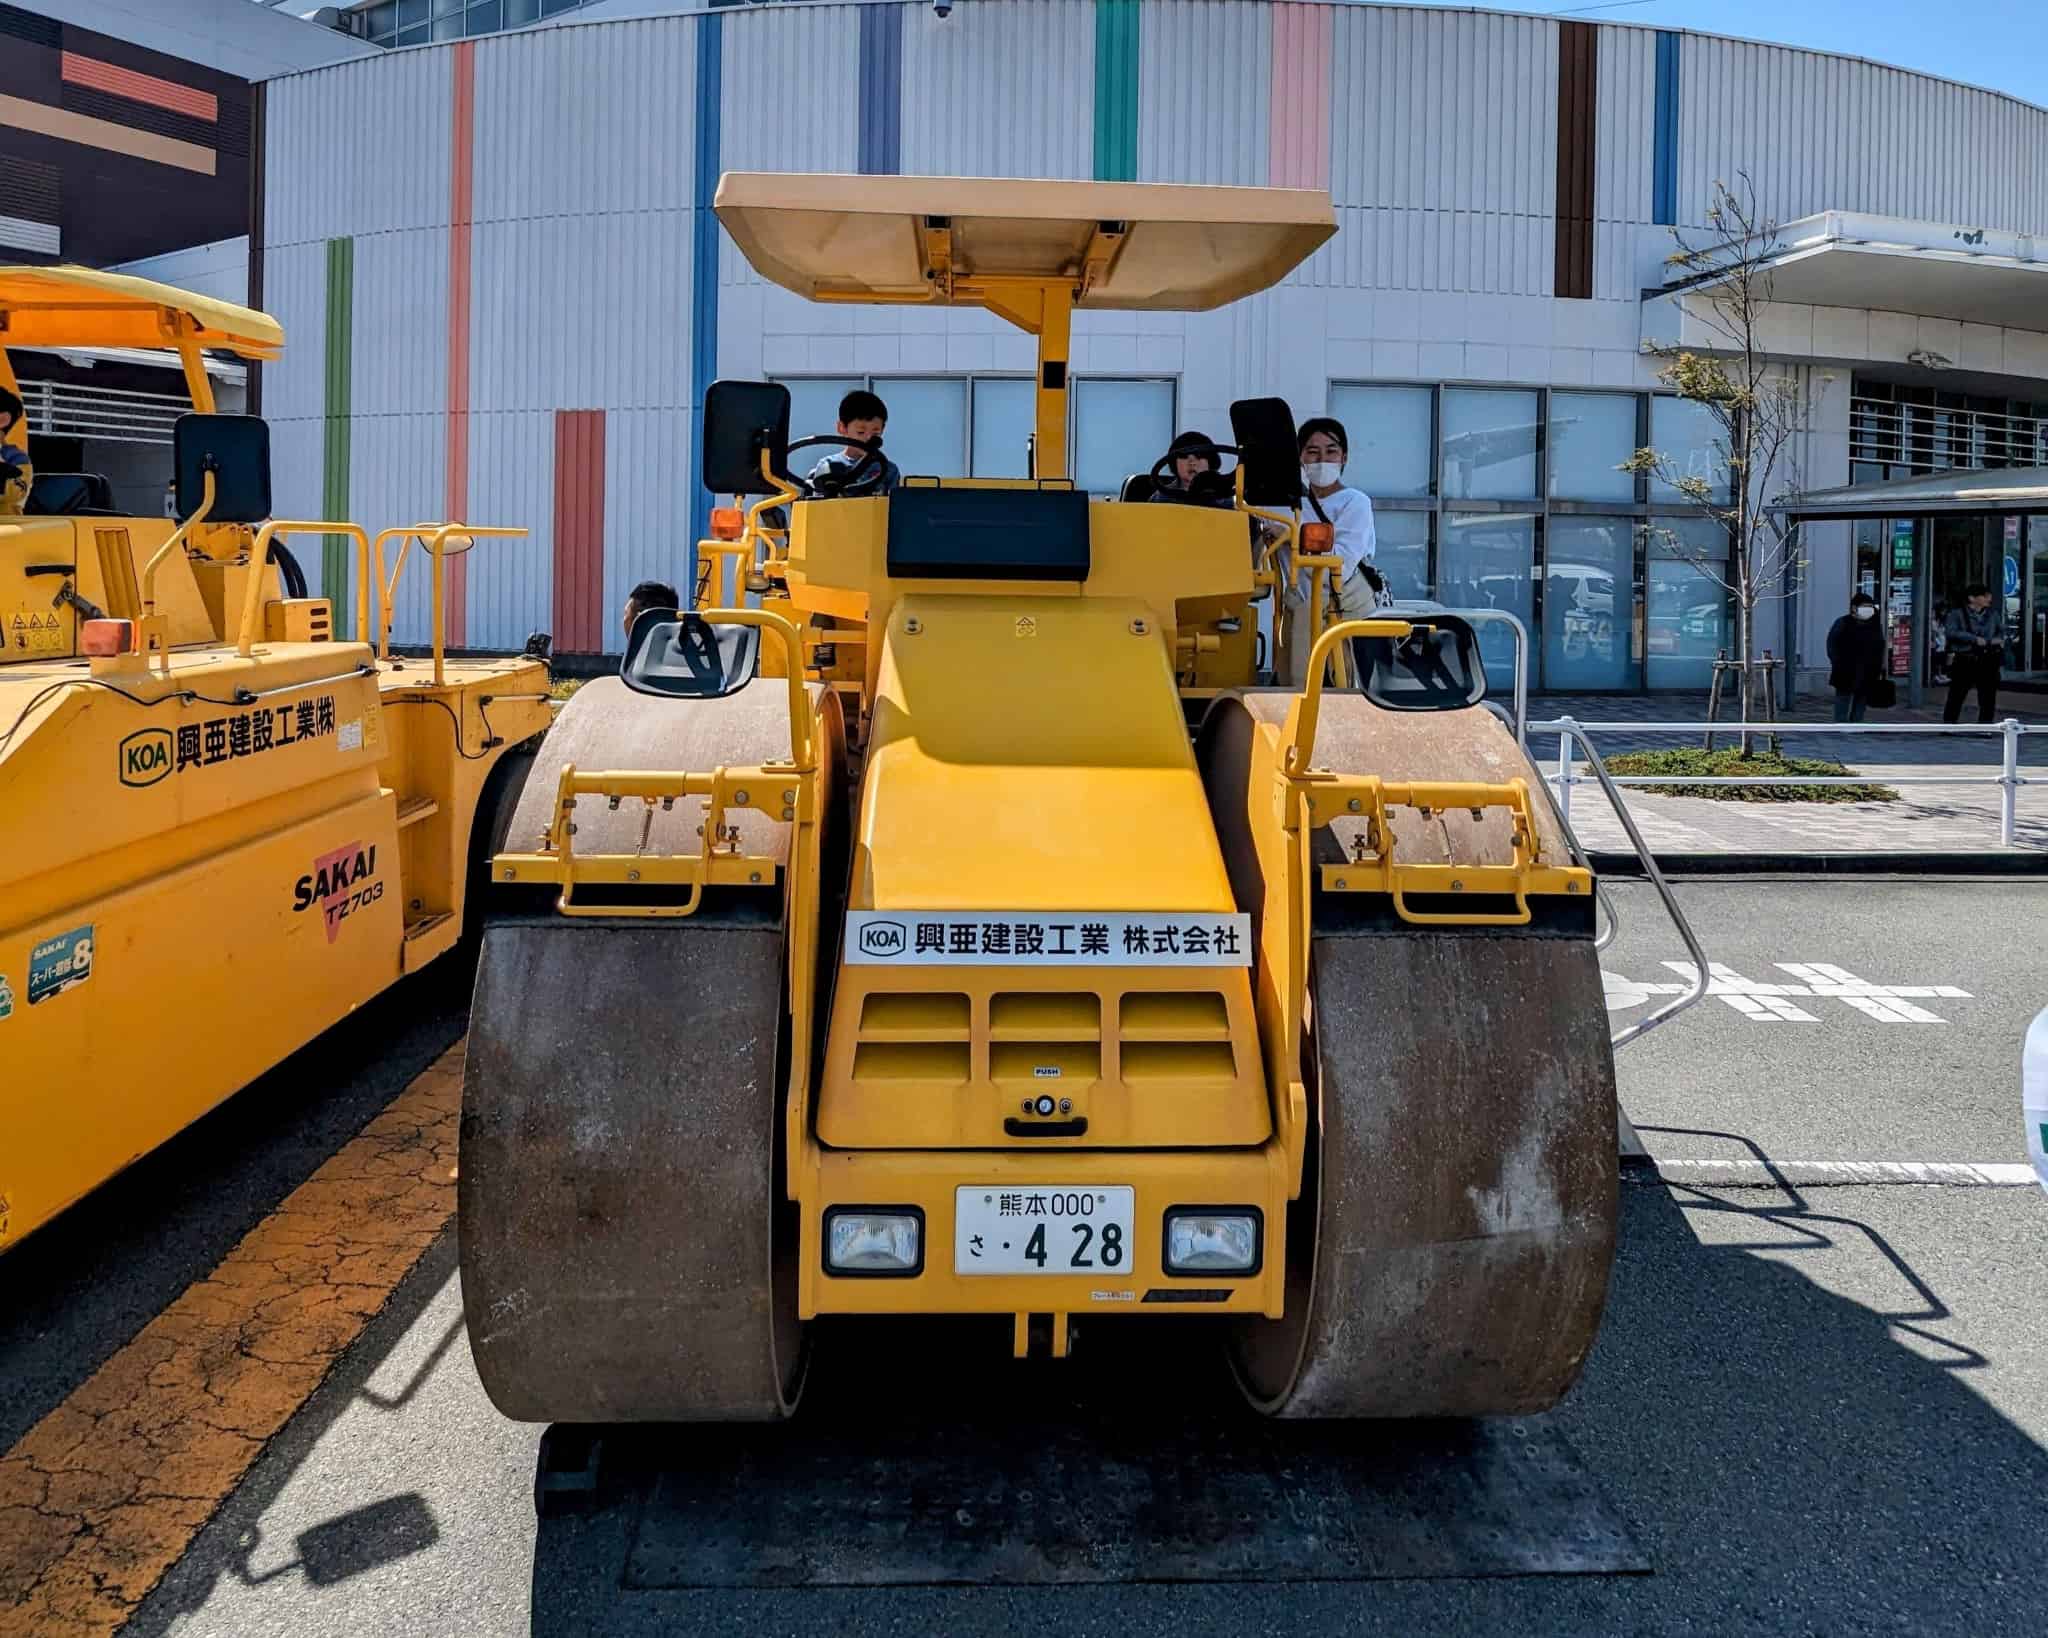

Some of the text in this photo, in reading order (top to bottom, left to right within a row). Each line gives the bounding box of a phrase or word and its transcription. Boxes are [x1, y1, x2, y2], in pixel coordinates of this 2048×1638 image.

[128, 741, 169, 774] KOA
[292, 845, 376, 912] SAKAI
[326, 881, 384, 925] TZ703
[866, 923, 1241, 956] KOA 興亜建設工業 株式会社
